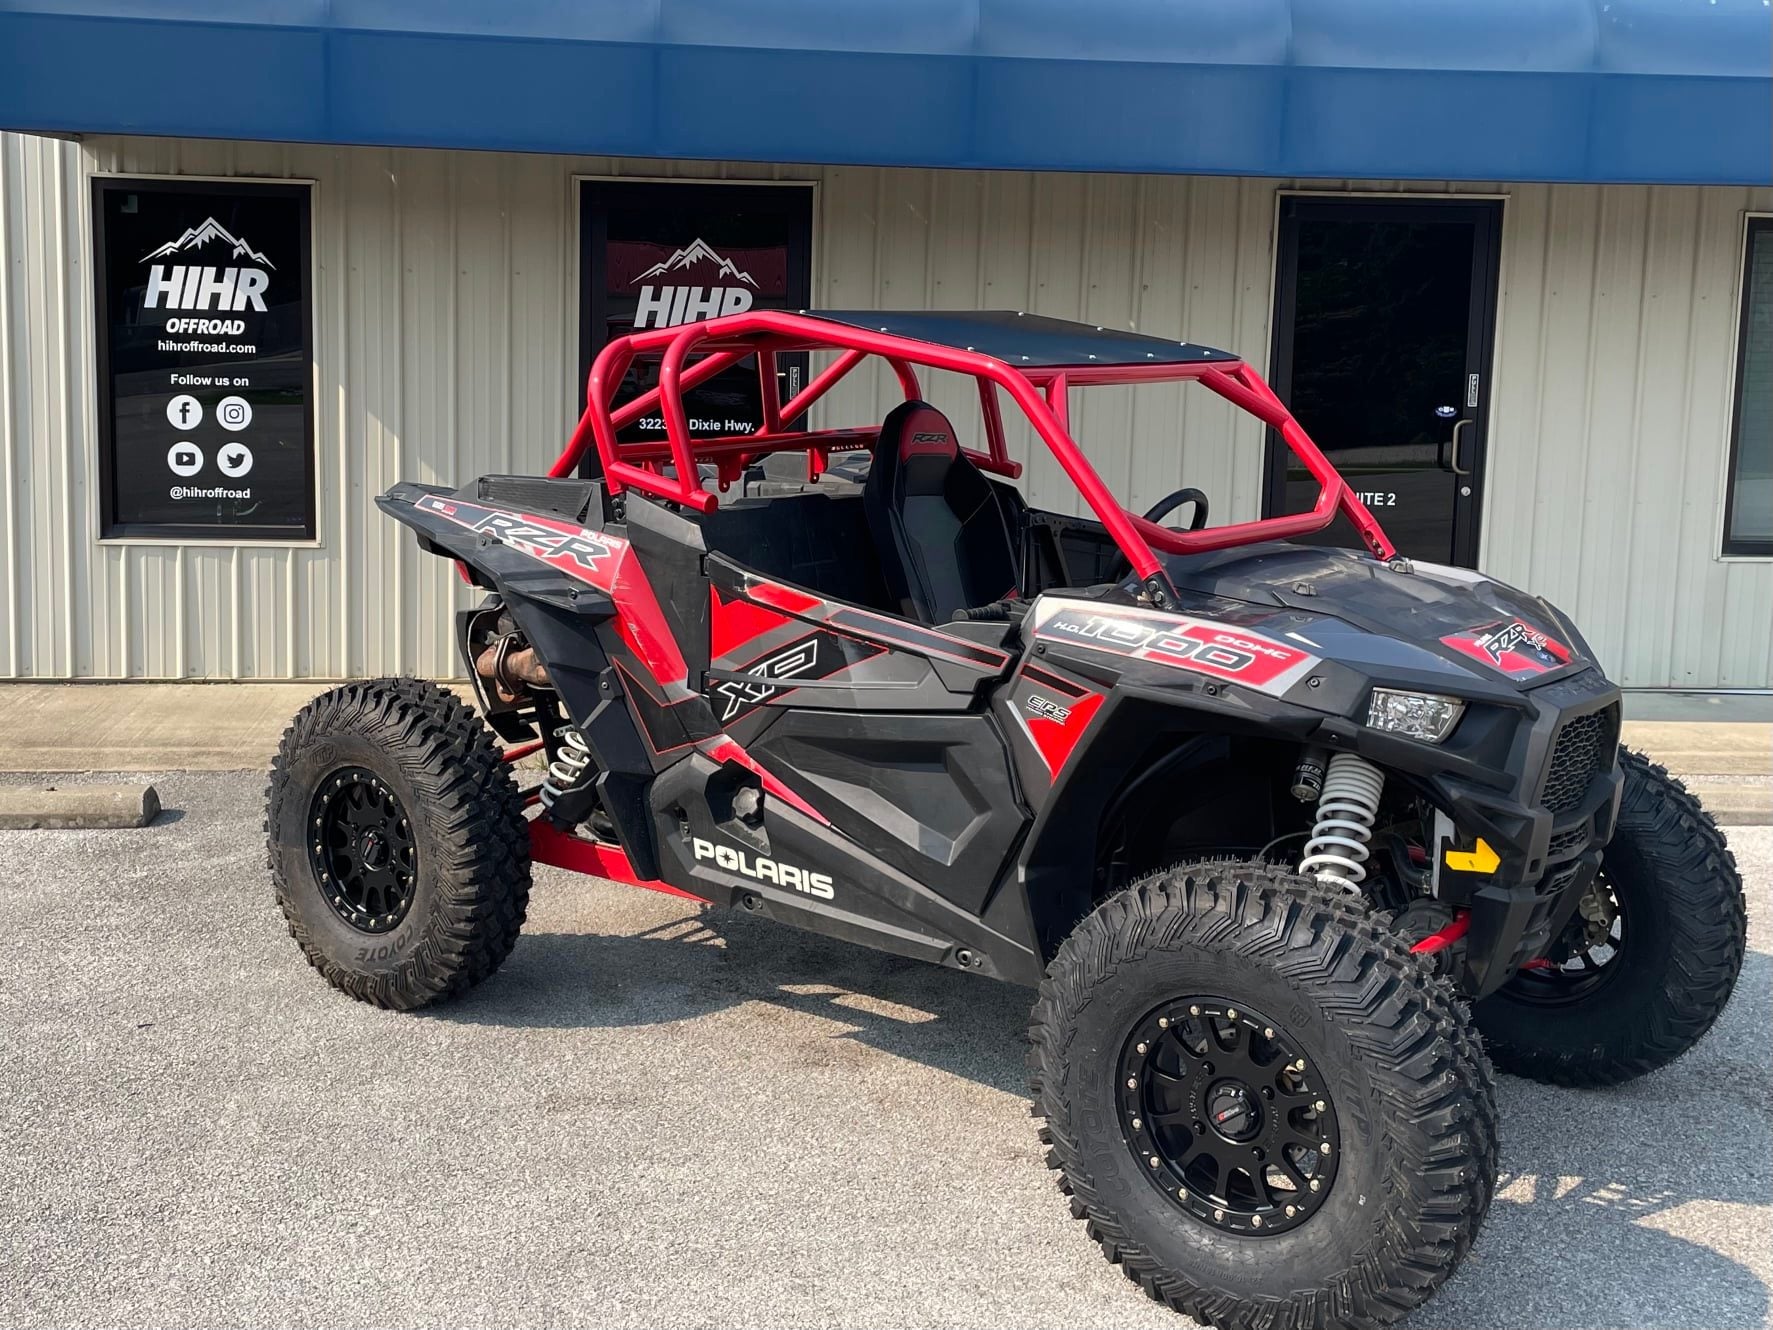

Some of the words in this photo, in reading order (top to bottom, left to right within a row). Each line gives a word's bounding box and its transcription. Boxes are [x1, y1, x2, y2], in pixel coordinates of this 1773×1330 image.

[144, 265, 270, 312] HIHR
[166, 318, 245, 335] OFFROAD
[157, 340, 256, 354] hihroffroad.com
[170, 374, 211, 386] Follow
[215, 377, 230, 387] us
[233, 377, 249, 387] on
[689, 419, 721, 431] Dixie
[725, 419, 755, 433] Hwy.
[911, 432, 948, 445] RZR
[169, 486, 251, 499] @hihroffroad
[1356, 492, 1384, 505] ITE
[1387, 492, 1396, 506] 2
[472, 512, 612, 572] RZR
[580, 529, 623, 549] POLARIS
[1079, 615, 1257, 673] 1000
[1214, 633, 1292, 660] DOHC
[1483, 622, 1536, 666] RZR
[717, 639, 818, 721] XP
[1027, 694, 1072, 720] EPS
[693, 837, 835, 900] POLARIS
[354, 923, 414, 963] COYOTE
